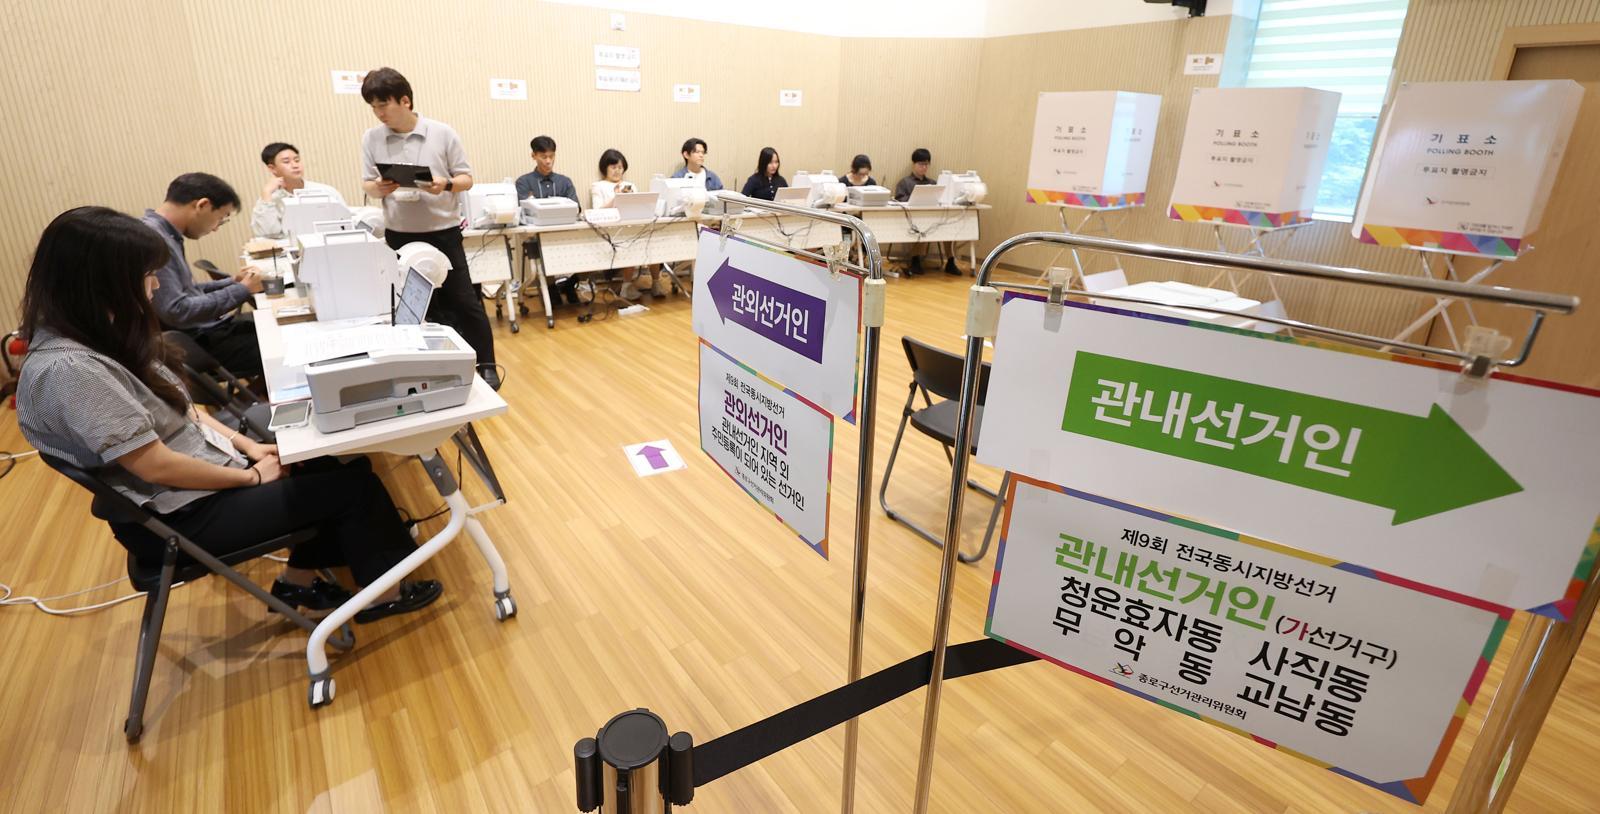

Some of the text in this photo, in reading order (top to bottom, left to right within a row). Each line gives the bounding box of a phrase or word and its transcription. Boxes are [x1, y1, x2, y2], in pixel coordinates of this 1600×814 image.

[1422, 166, 1488, 177] 투표지 촬영금지
[1426, 147, 1494, 157] POLLING BOOTH
[731, 283, 809, 344] 관외선거인
[724, 389, 788, 456] 관외선거인
[725, 373, 785, 419] 제9회 전국동시지방선거
[1091, 378, 1363, 478] 관내선거인
[711, 425, 805, 512] 주민등록이 되어 있는 선거인
[722, 416, 789, 481] 관내선거인 지역 외
[1120, 528, 1337, 604] 제9회 전국동시지방선거
[1055, 532, 1398, 670] 관내선거인 (가선거구)
[1052, 606, 1356, 737] 무 악 동 교남동
[1060, 576, 1370, 703] 청운효자동 사직동
[1137, 672, 1247, 720] 종로구선거관리위원회
